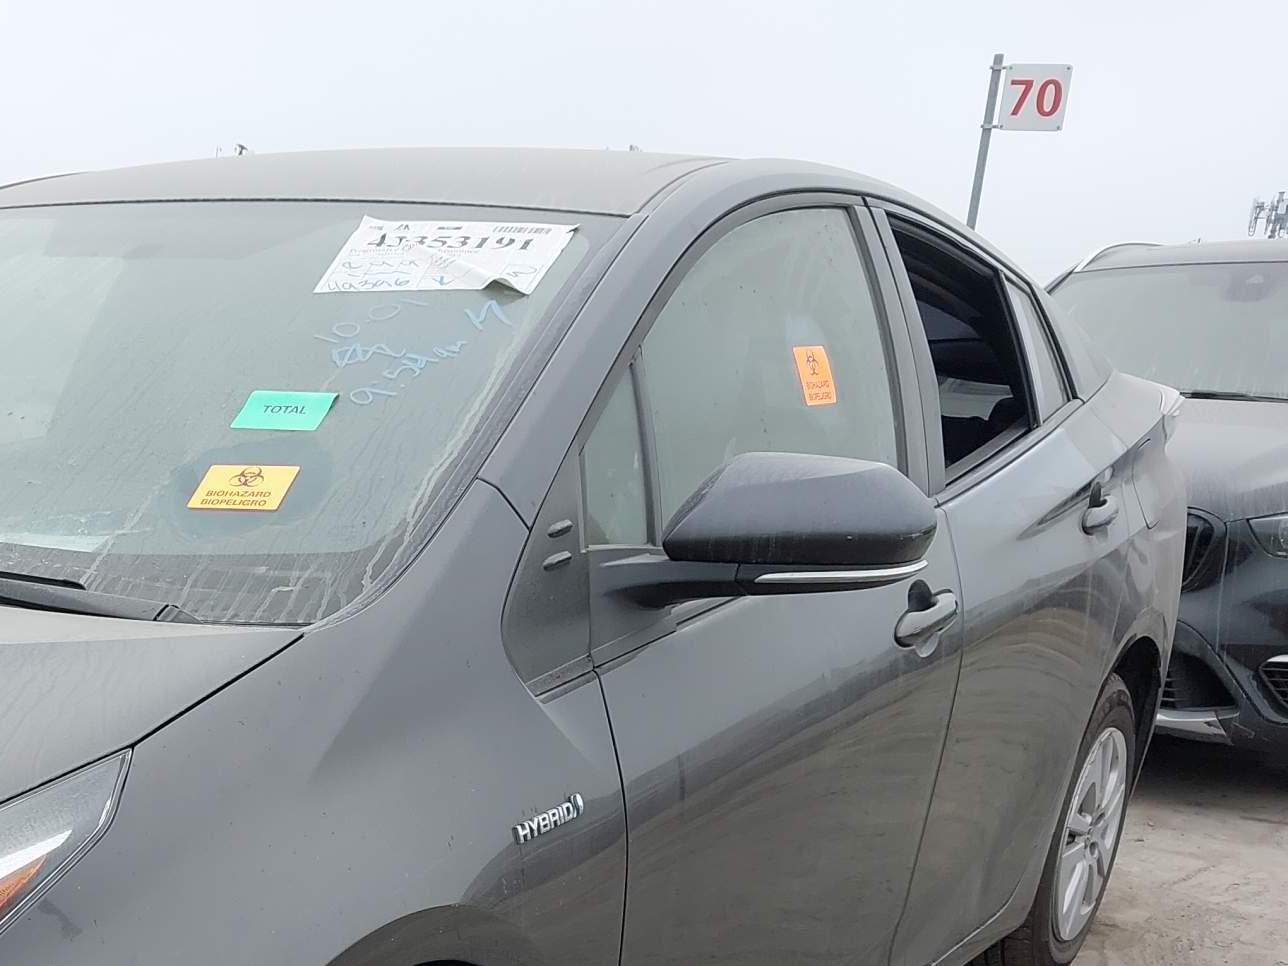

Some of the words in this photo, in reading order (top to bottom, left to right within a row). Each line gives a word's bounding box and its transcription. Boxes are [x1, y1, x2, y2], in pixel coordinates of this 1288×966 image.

[1010, 78, 1063, 117] 70
[367, 232, 534, 251] 43353191
[263, 404, 307, 415] TOTAL
[206, 490, 272, 498] BIOHAZARD
[200, 498, 267, 507] BIOPELIGRO
[515, 801, 574, 844] HYBRID
